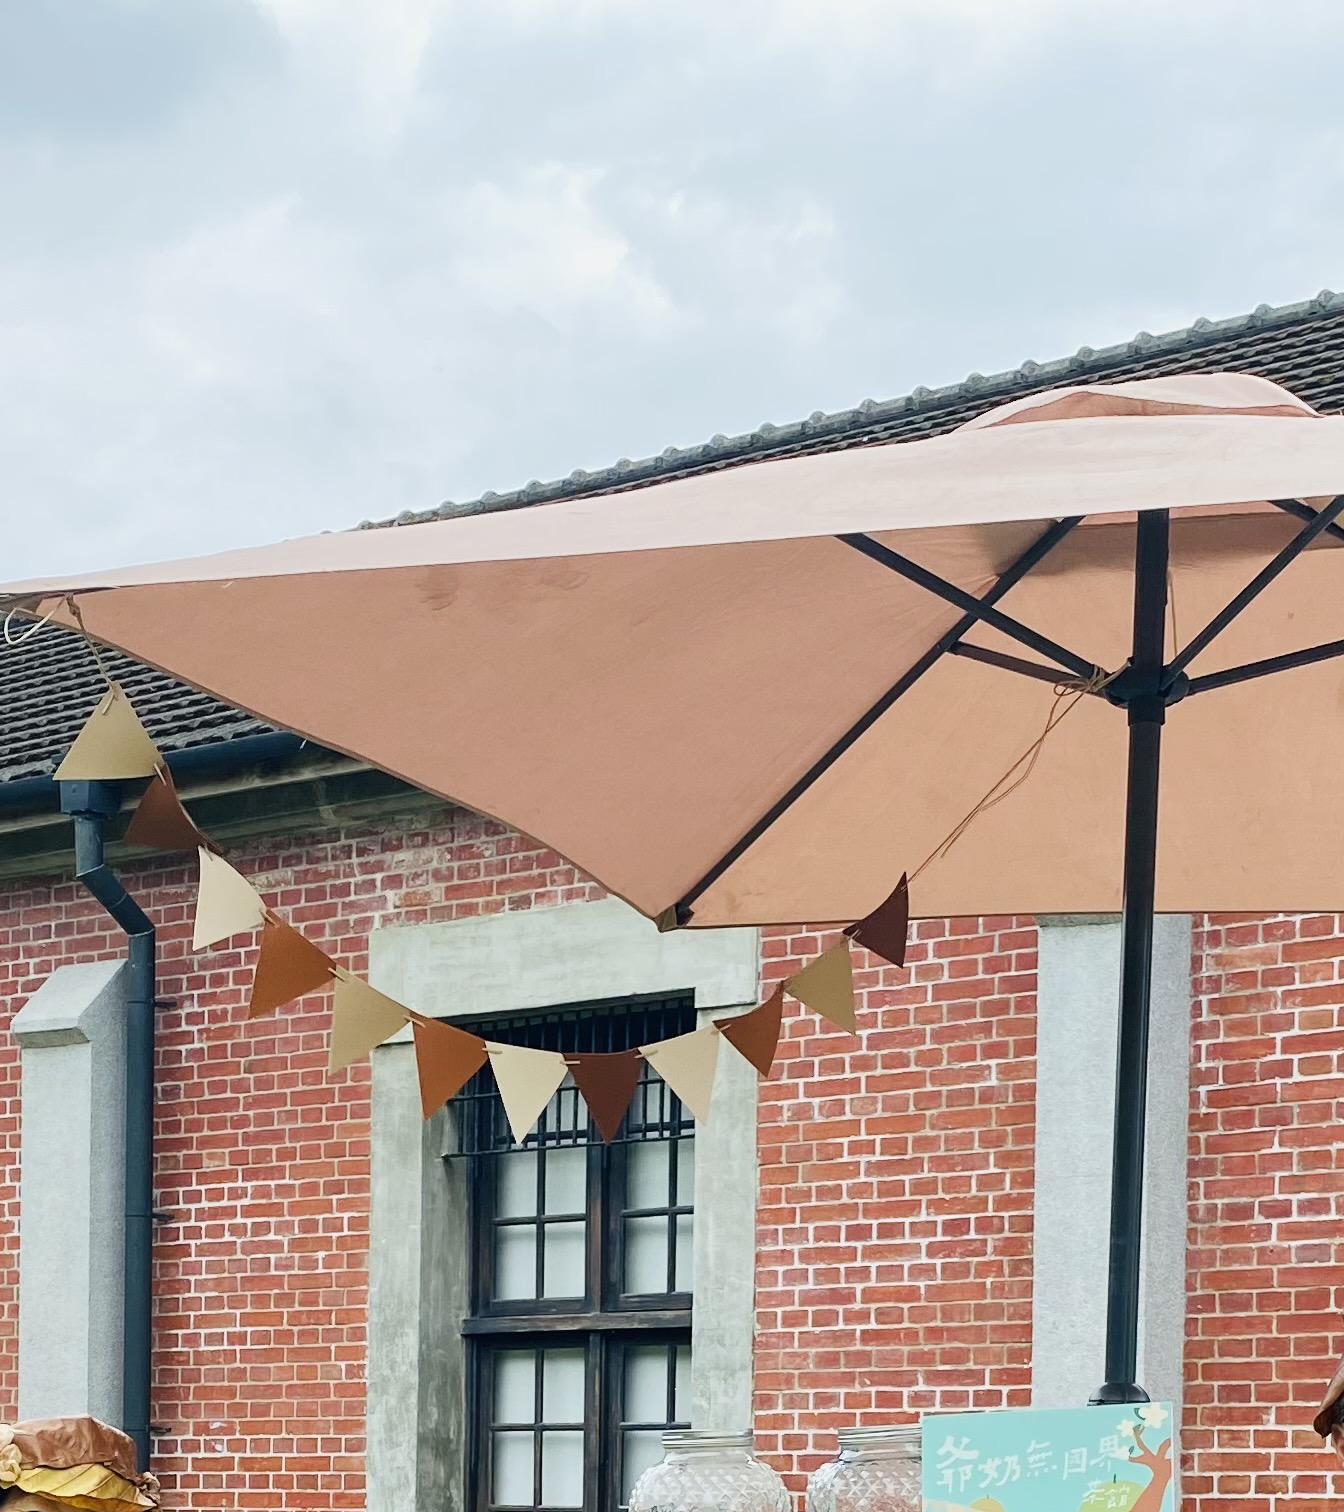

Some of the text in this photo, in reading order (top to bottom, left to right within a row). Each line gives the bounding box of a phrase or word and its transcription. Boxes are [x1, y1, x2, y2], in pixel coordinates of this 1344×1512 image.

[936, 1435, 1129, 1493] 爺奶無國界
[1082, 1477, 1131, 1509] 茶館
